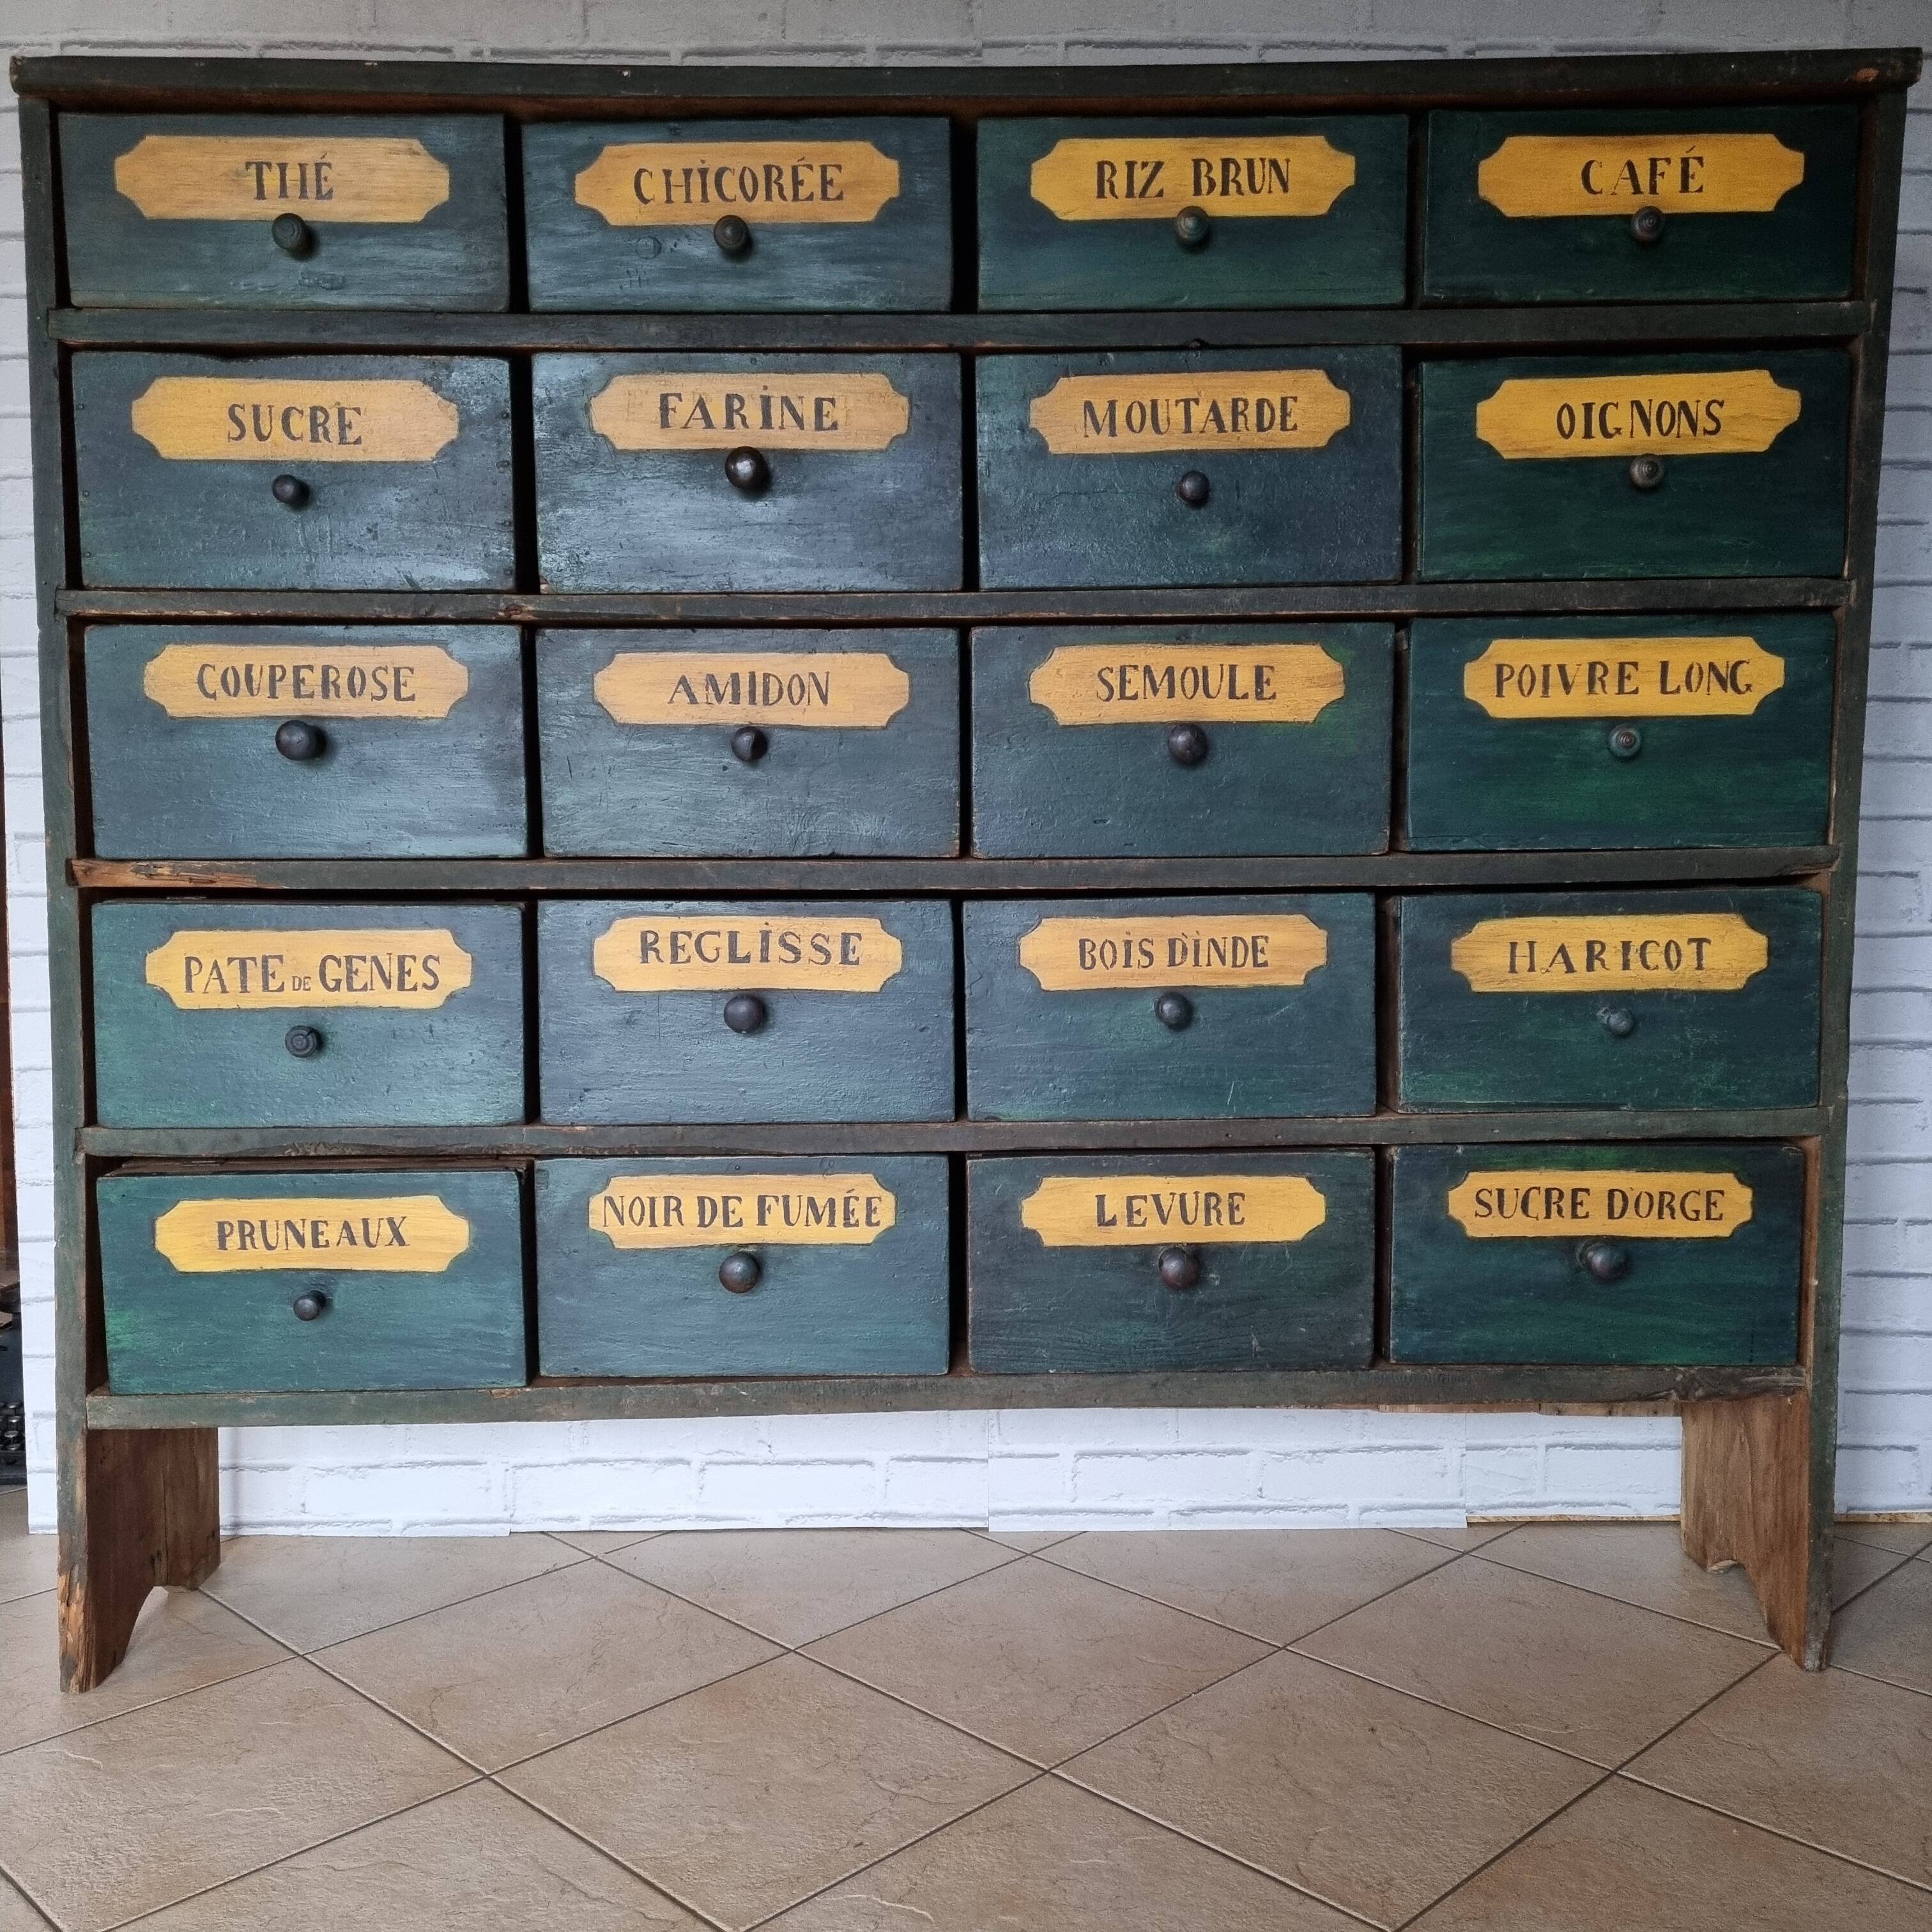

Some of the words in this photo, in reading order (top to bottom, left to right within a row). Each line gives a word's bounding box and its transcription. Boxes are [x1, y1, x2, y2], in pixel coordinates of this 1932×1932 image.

[245, 153, 334, 201] THÉ
[1096, 160, 1165, 199] RIZ
[1191, 157, 1291, 197] BRUN
[1581, 147, 1705, 195] CAFÉ
[227, 401, 362, 445] SUCRE
[1084, 395, 1298, 438] MOUTARDE
[1556, 399, 1725, 440] OIGNONS
[195, 663, 416, 702] COUPEROSE
[668, 671, 830, 707] AMIDON
[1097, 663, 1276, 702] SEMOULE
[1494, 661, 1639, 698] POIVRE
[1659, 659, 1752, 695] LONG
[184, 954, 285, 994] PATE
[291, 975, 312, 992] DE
[318, 953, 440, 993] GENES
[1508, 937, 1712, 974] HARICOT
[602, 1193, 684, 1229] NOIR
[696, 1195, 744, 1229] DE
[756, 1188, 883, 1229] FUMÉE
[1095, 1190, 1246, 1227] LEVURE
[1475, 1186, 1591, 1221] SUCRE
[216, 1216, 410, 1251] PRUNEAUX
